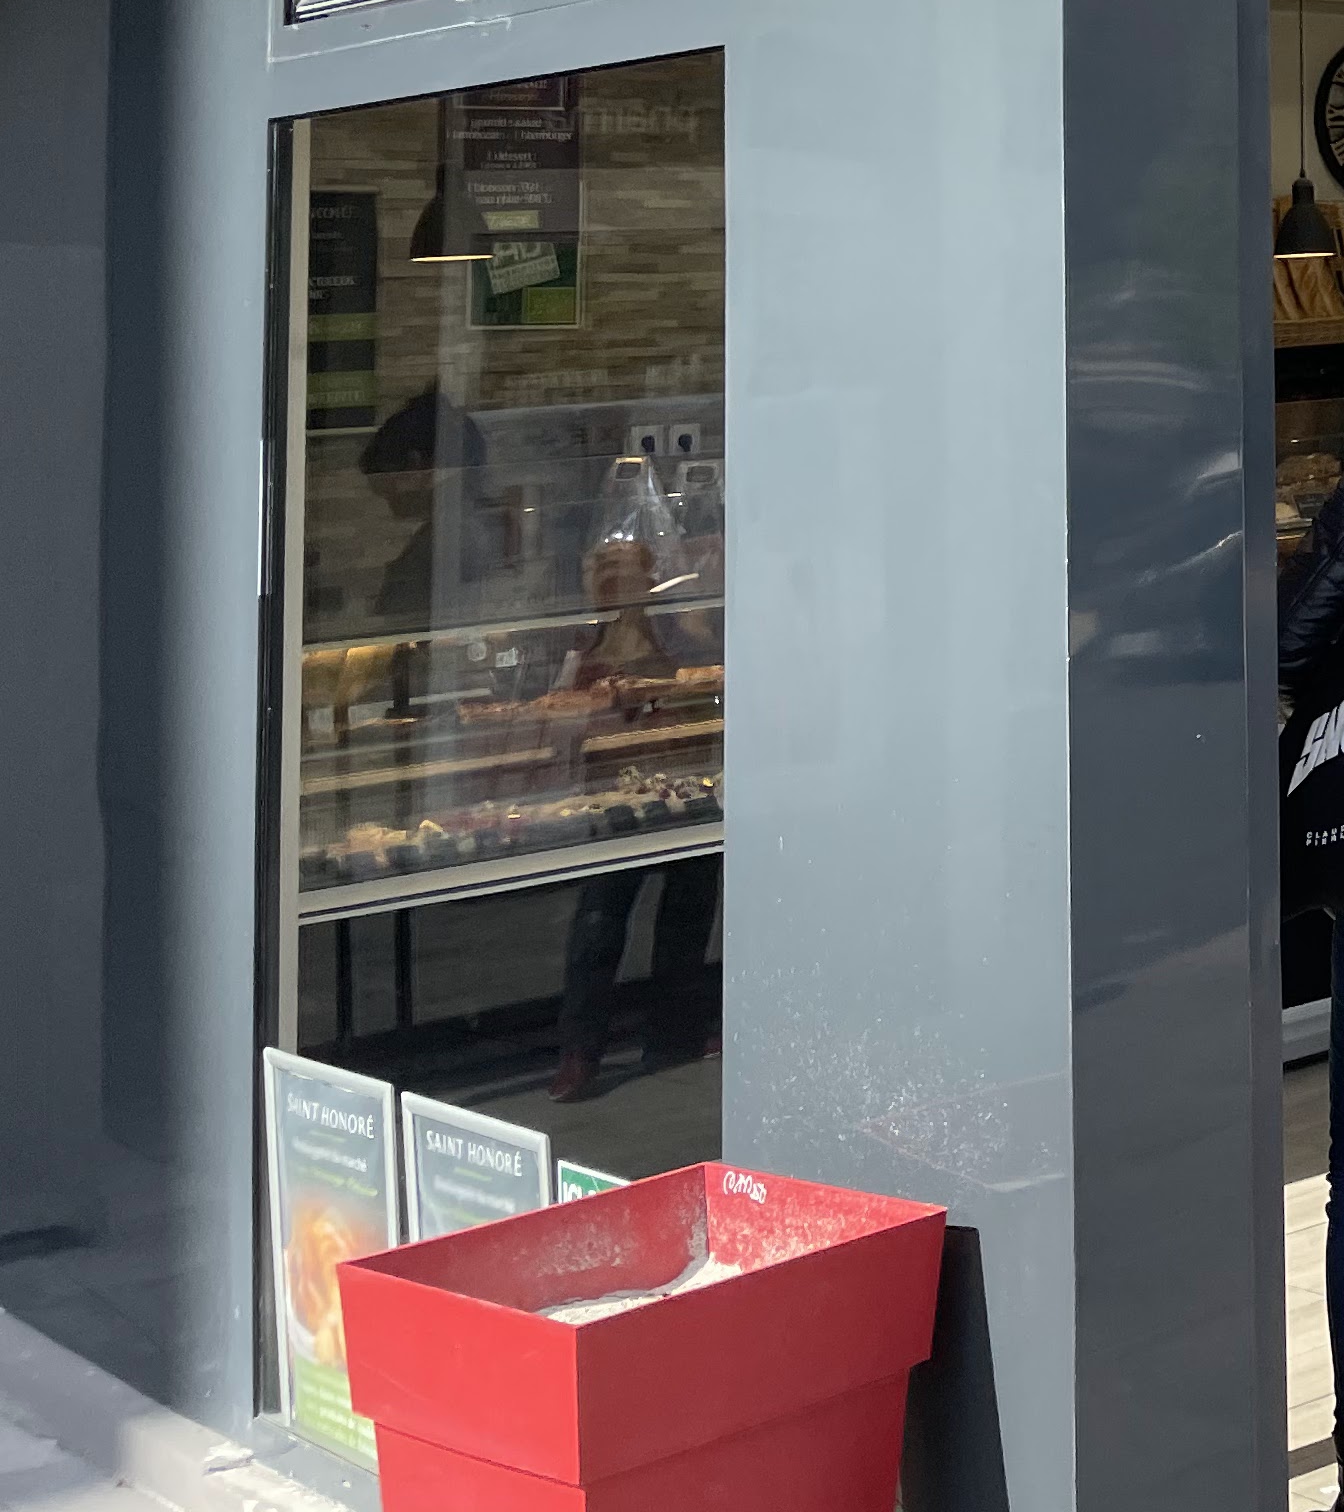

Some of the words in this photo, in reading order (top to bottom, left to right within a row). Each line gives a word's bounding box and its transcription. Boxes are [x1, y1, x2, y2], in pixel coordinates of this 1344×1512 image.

[287, 1092, 320, 1123] SAINT
[320, 1105, 375, 1140] HONORÉ
[425, 1129, 465, 1159] SAINT
[467, 1141, 523, 1178] HONORÉ
